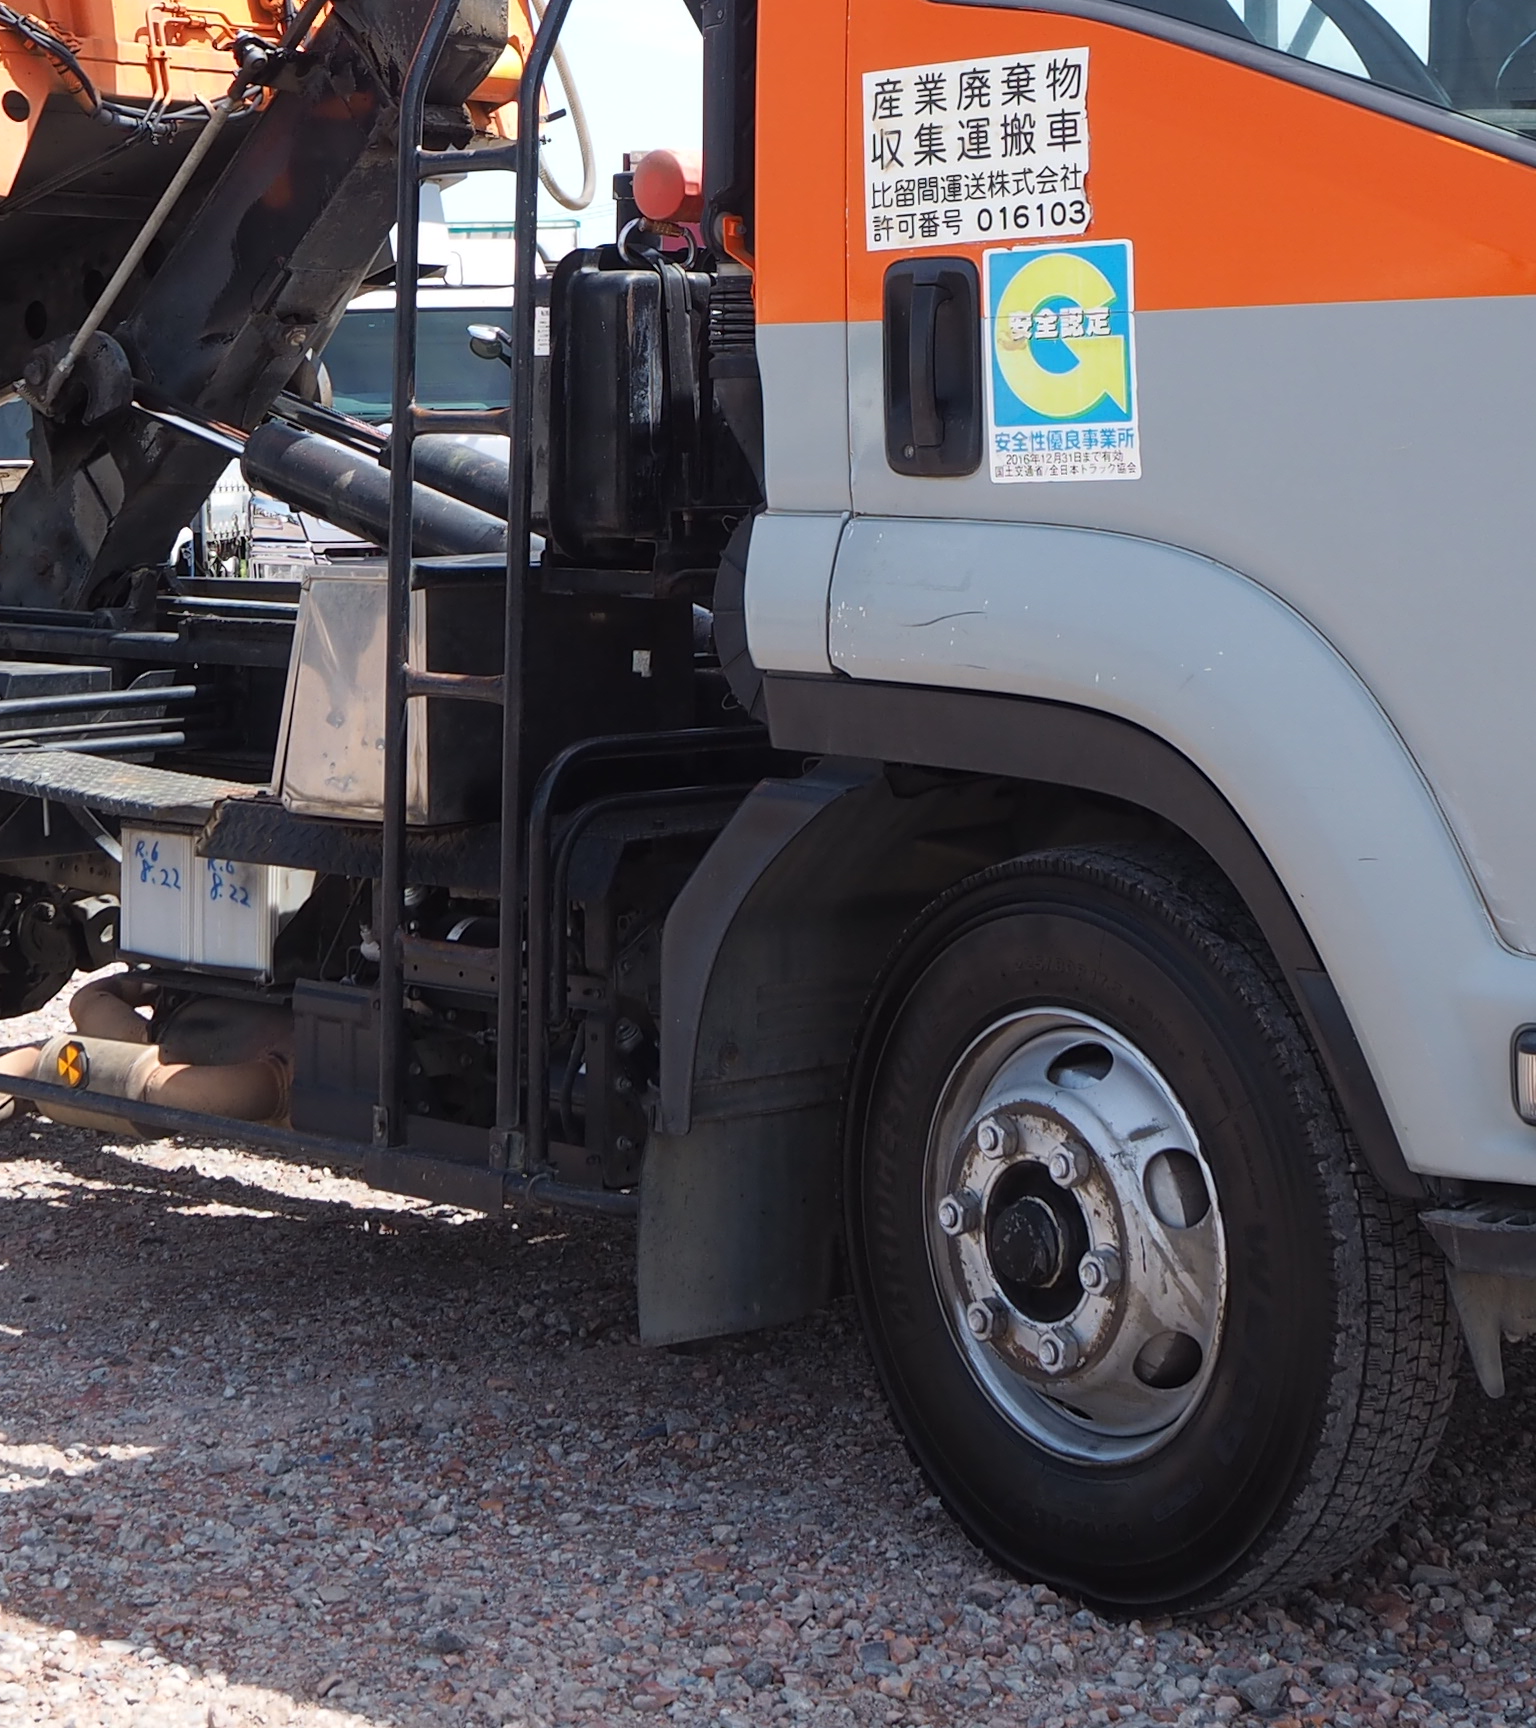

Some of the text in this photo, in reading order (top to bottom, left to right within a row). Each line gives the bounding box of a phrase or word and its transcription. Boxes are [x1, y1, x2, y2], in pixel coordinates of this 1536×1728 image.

[872, 57, 1082, 121] 産業廃棄物
[870, 108, 1082, 170] 収集運搬車
[871, 162, 1082, 209] 比留間運送株式会社
[872, 200, 1086, 242] 許可番号 016103
[1008, 308, 1112, 341] 安全認定
[995, 427, 1134, 452] 安全性優良事業所
[1005, 449, 1124, 465] 2016年12月31日まで有効
